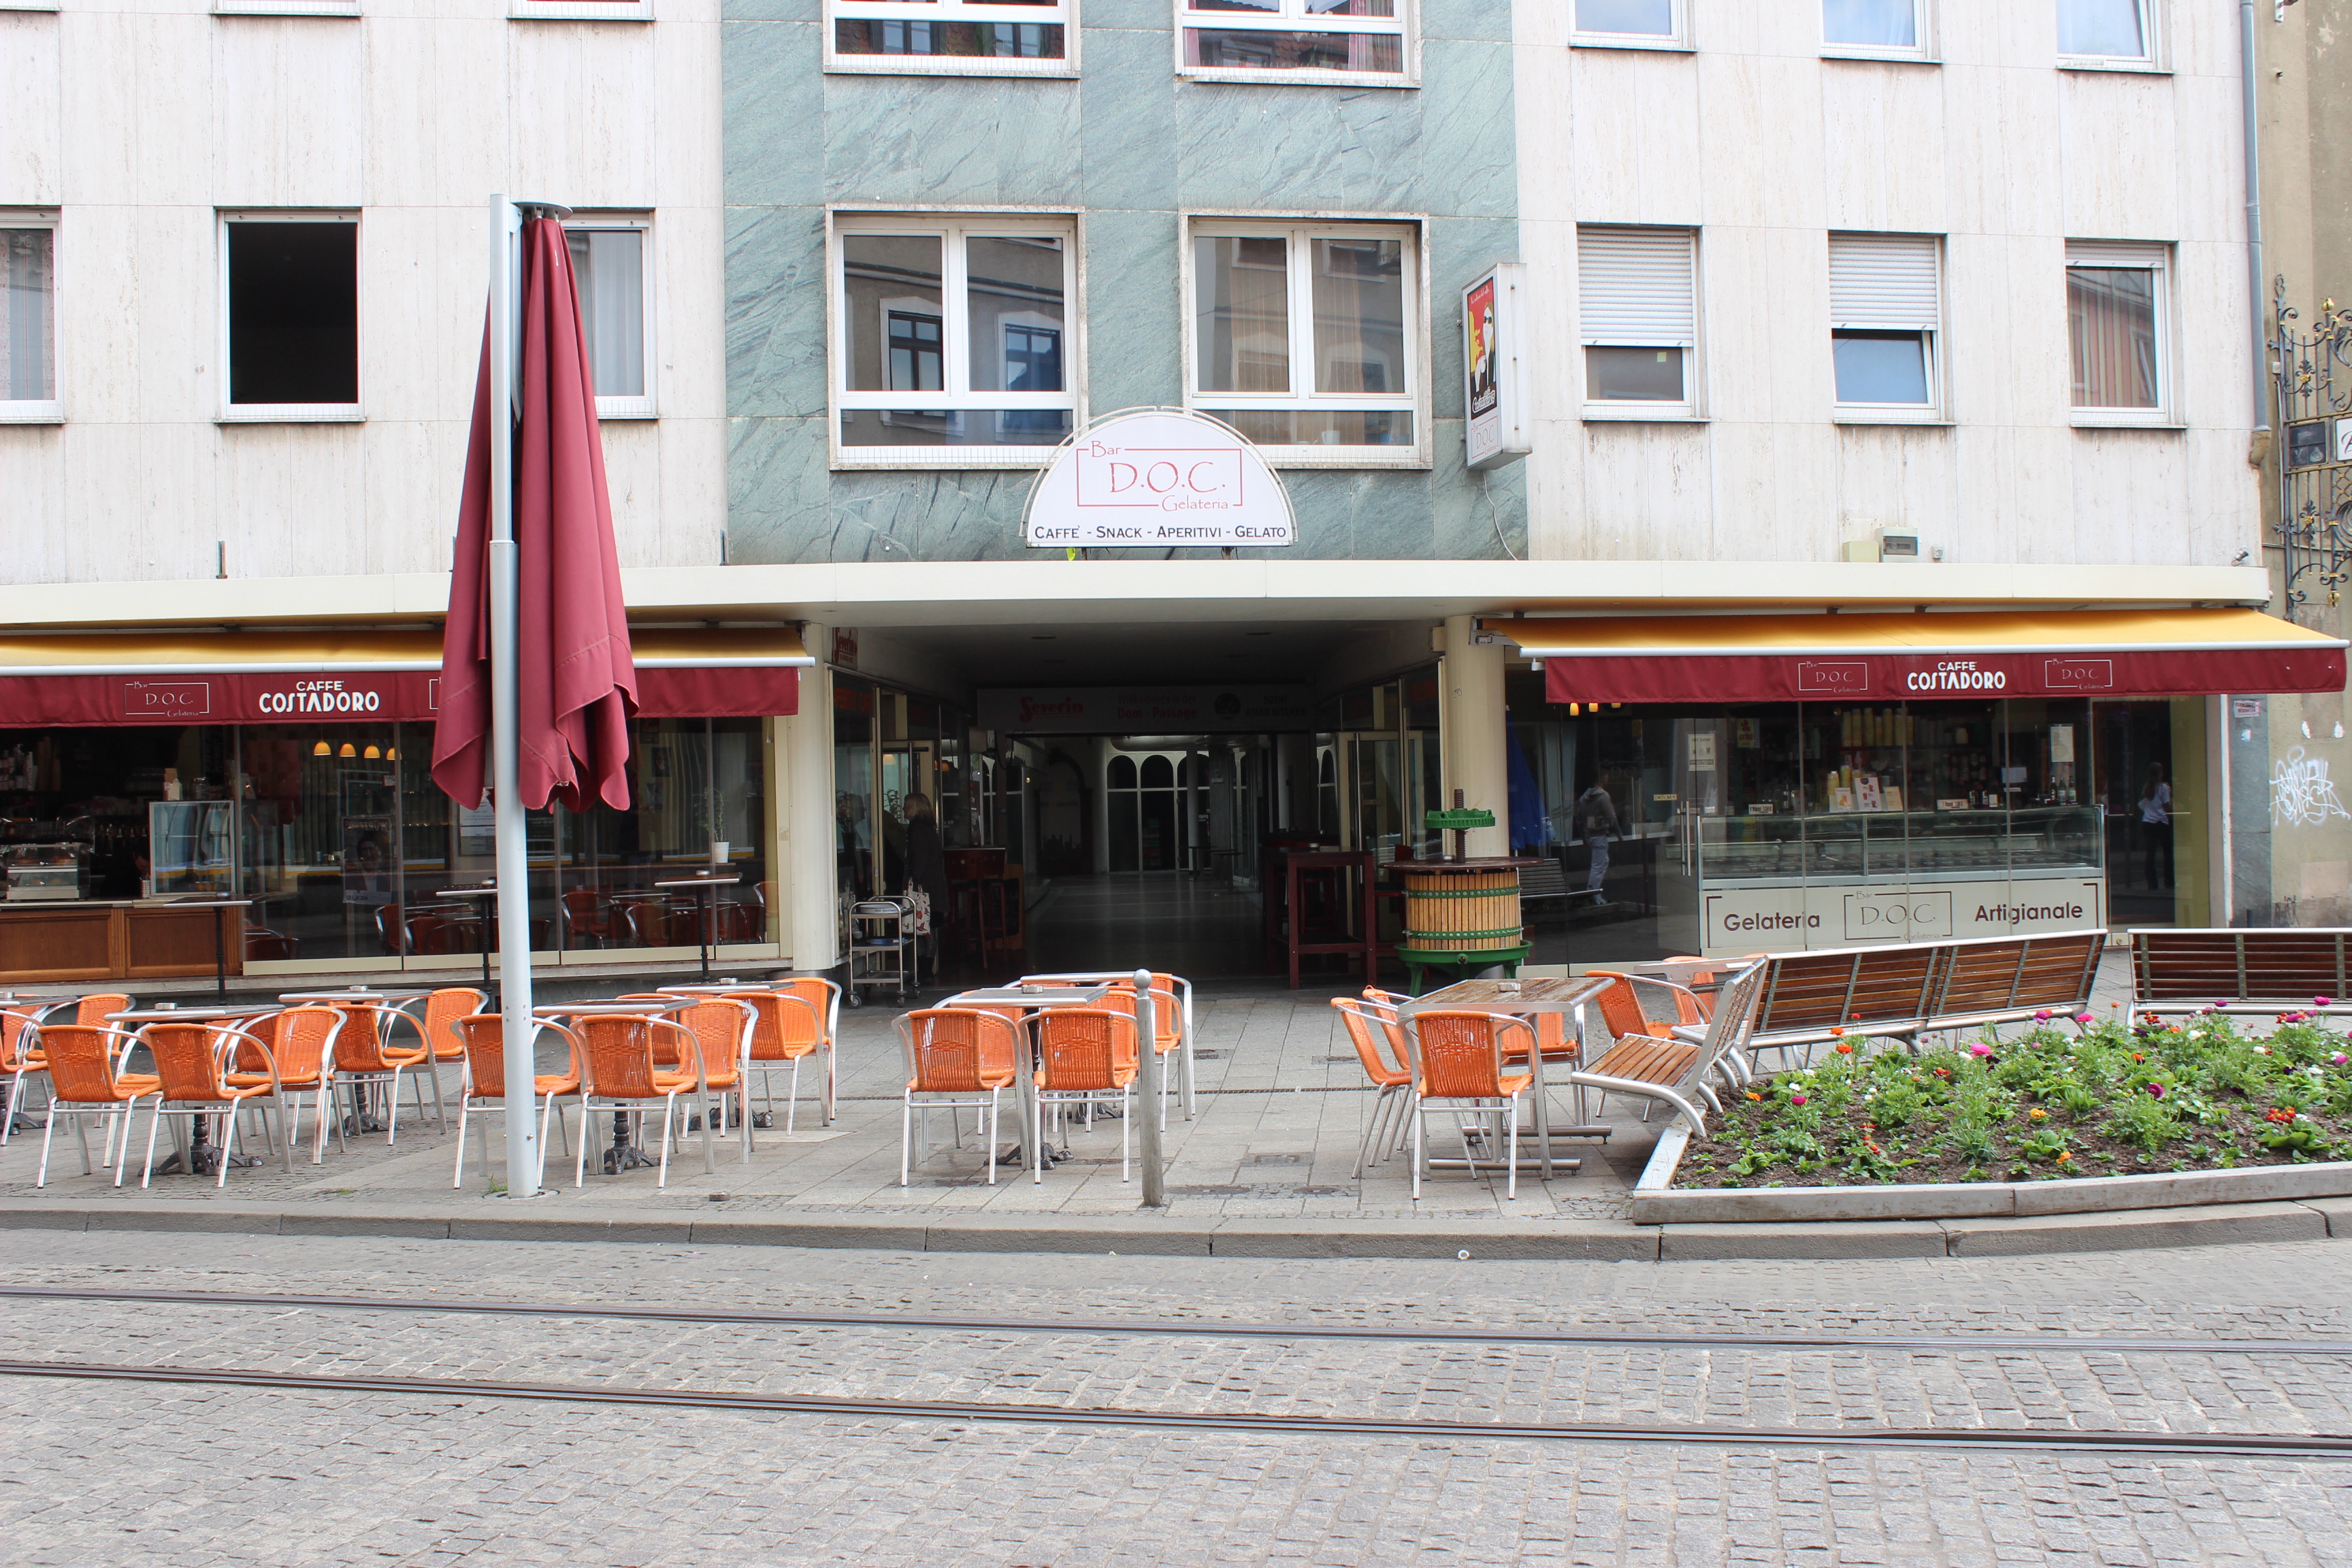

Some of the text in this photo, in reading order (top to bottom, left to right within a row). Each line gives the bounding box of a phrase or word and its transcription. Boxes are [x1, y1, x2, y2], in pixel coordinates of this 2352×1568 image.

[1091, 440, 1122, 458] Bar
[1109, 461, 1226, 493] D.O.C.
[1162, 495, 1228, 512] Gelateria
[1096, 526, 1143, 538] SNACK
[1156, 525, 1222, 538] APERITIVI
[1235, 525, 1286, 538] GELATO
[1806, 660, 1818, 668] Bar
[133, 681, 149, 689] Bar
[1907, 671, 2006, 691] COSTADORO
[145, 692, 194, 705] D.O.C.
[259, 691, 380, 713] COSTADORO
[1117, 693, 1196, 704] Willkommen in der
[1263, 696, 1288, 704] SUSHI
[167, 709, 199, 717] Gelateria
[1019, 696, 1084, 723] Severin
[1117, 707, 1143, 719] Dom
[1153, 706, 1198, 720] Passage
[1245, 706, 1307, 717] ASIAN KITCHEN
[1856, 890, 1874, 900] Bar
[1861, 903, 1936, 926] D.O.C.
[1974, 902, 2084, 925] Artigianale
[1724, 911, 1820, 931] Gelateria
[1904, 932, 1940, 941] Gelateria
